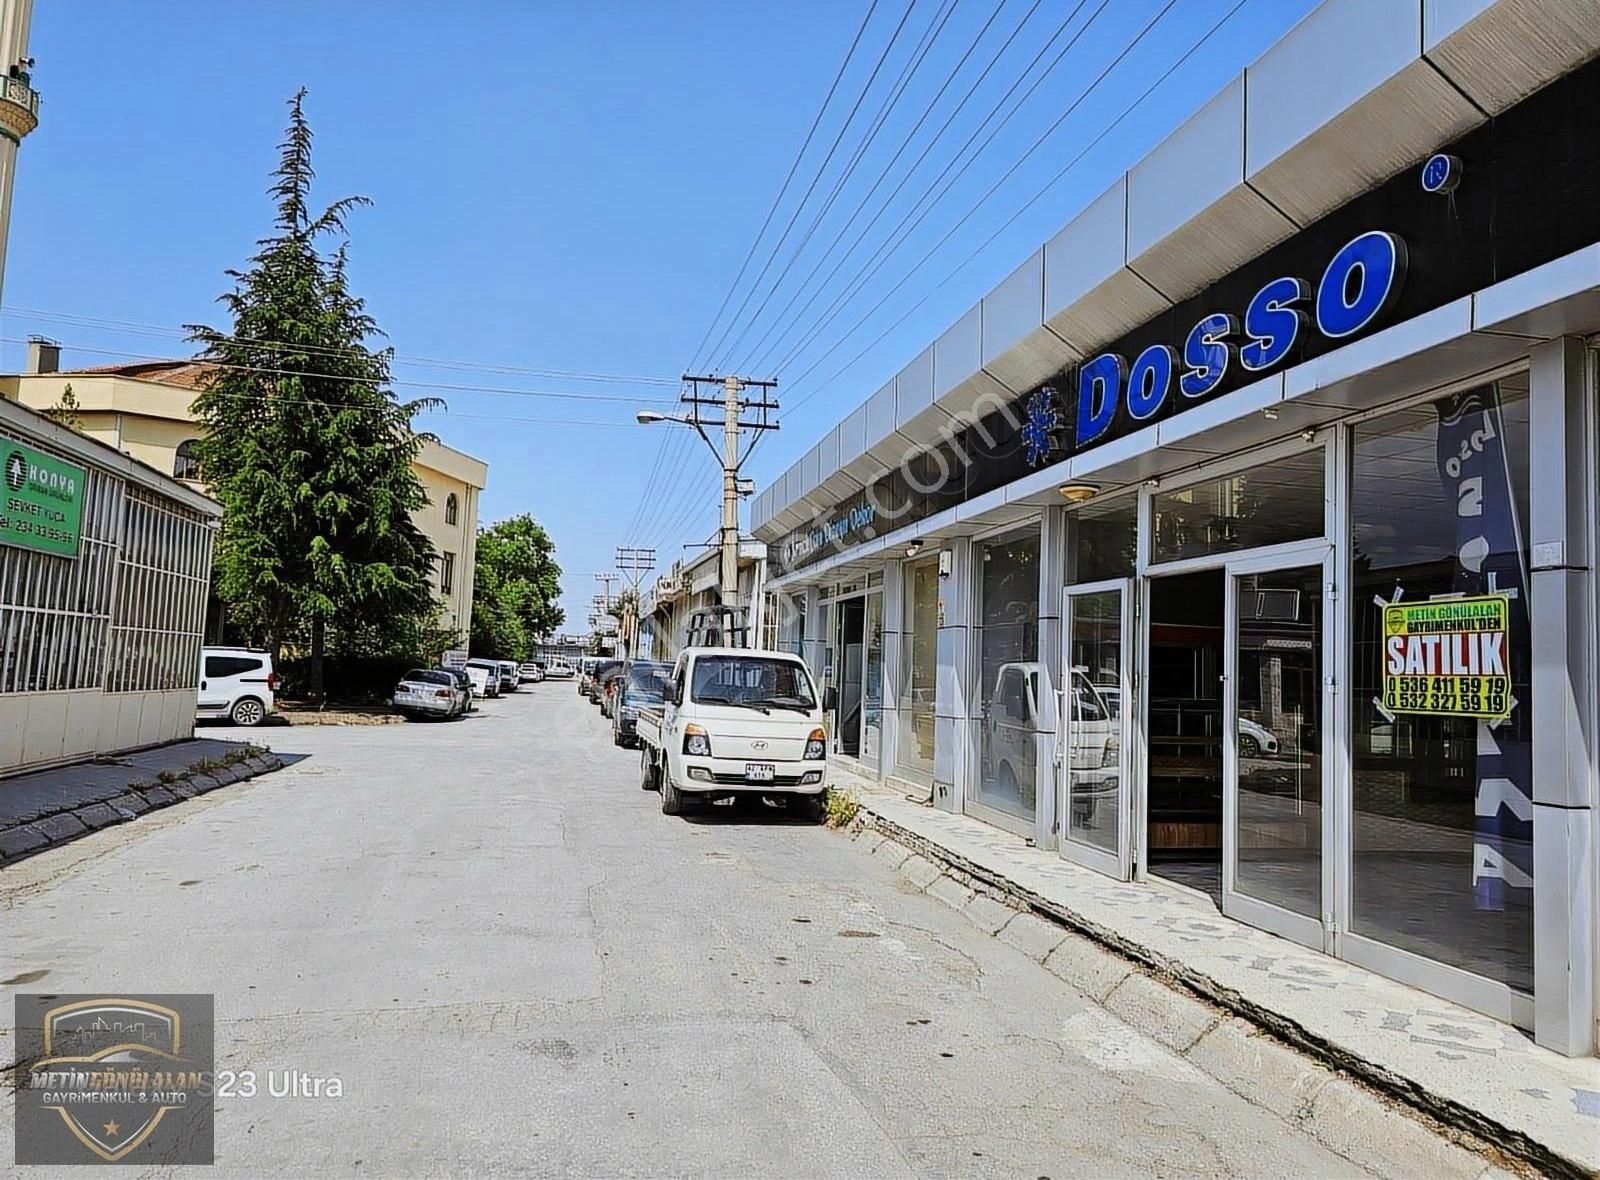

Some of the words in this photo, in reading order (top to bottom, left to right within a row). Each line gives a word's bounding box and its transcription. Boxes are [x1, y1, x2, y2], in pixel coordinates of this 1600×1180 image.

[1387, 632, 1505, 676] SATILIK
[1400, 677, 1428, 693] 536
[1432, 677, 1455, 693] 411
[1459, 677, 1481, 694] 59
[1486, 678, 1505, 694] 19
[1400, 693, 1428, 708] 532
[1431, 693, 1456, 710] 327
[1461, 694, 1481, 711] 59
[1484, 694, 1504, 712] 19
